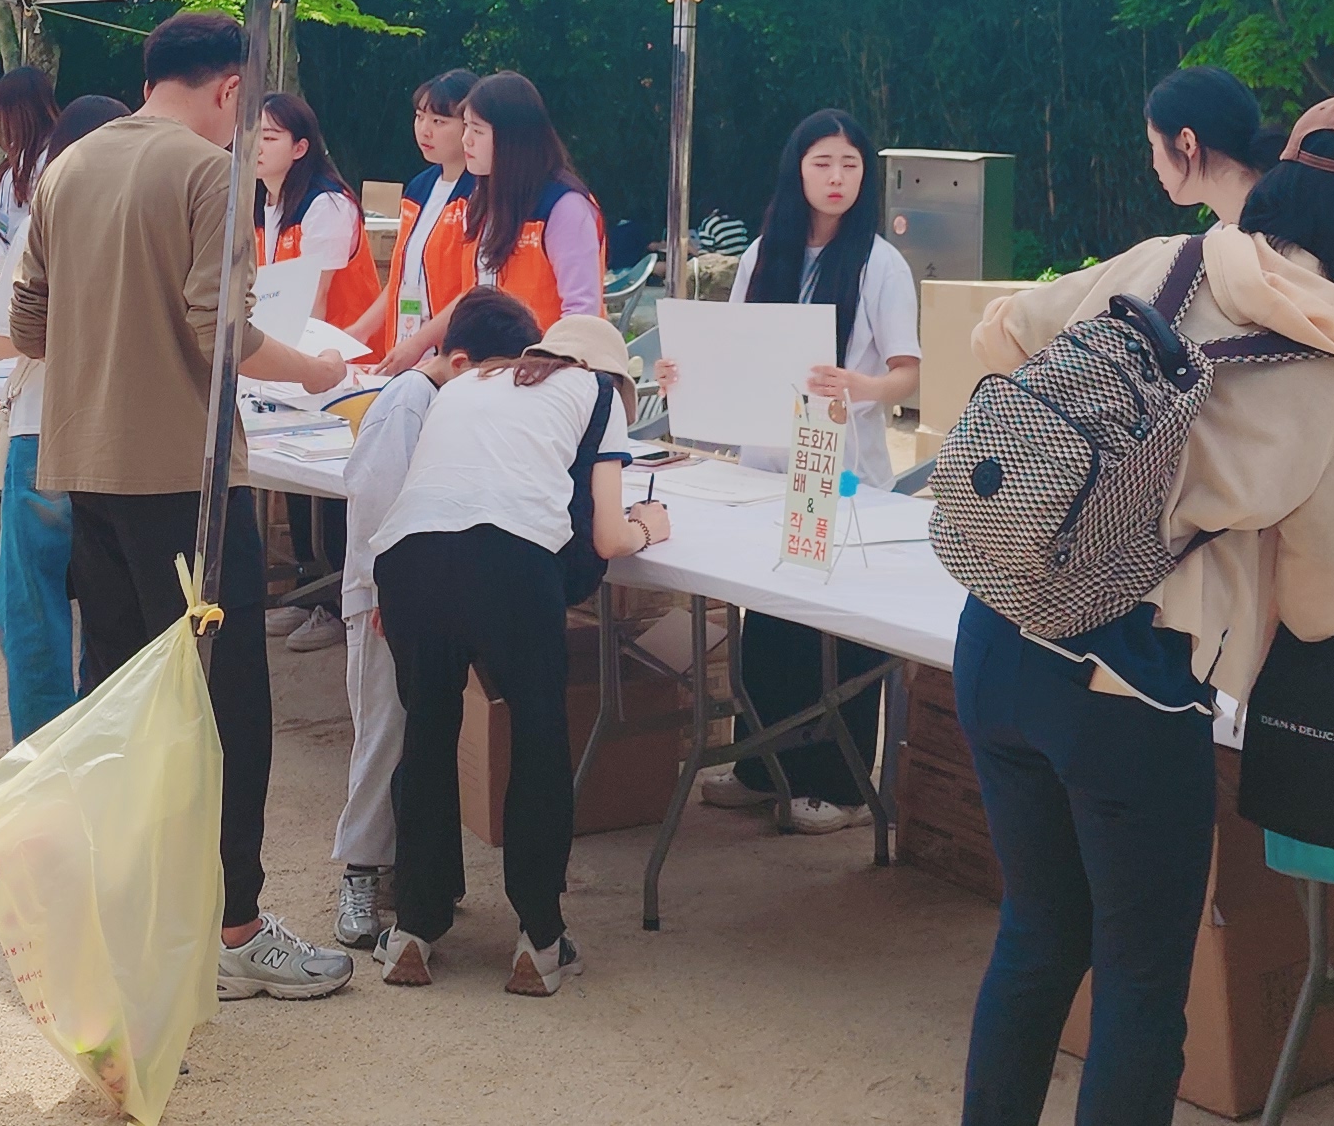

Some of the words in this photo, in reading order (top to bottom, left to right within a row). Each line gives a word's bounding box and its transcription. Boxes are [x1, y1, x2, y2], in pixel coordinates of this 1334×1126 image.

[797, 426, 838, 453] 도화지
[795, 450, 836, 476] 원고지
[807, 498, 815, 514] &
[787, 534, 827, 562] 접수처
[1261, 715, 1288, 729] DEAN
[1289, 723, 1297, 732] &
